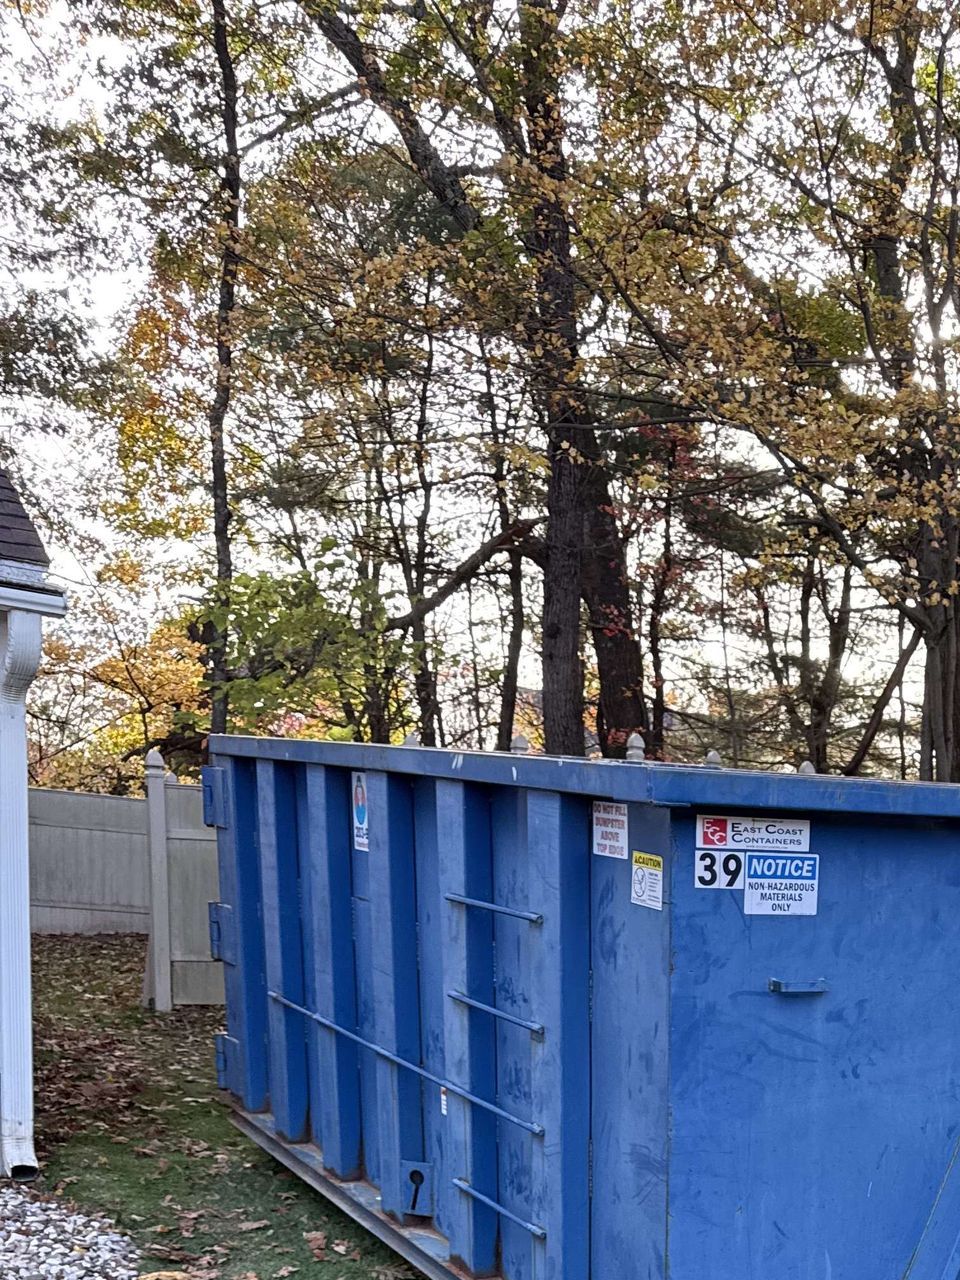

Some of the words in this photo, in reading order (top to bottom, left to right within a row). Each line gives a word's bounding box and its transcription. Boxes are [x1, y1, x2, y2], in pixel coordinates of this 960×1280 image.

[731, 822, 762, 834] EAST
[765, 824, 804, 836] COAST
[731, 833, 803, 846] CONTAINERS
[638, 855, 662, 869] CAUTION
[750, 858, 815, 877] NOTICE
[697, 852, 743, 887] 39
[748, 881, 815, 892] NON-HAZARDOUS
[760, 892, 803, 902] MATERIALS
[771, 903, 791, 912] ONLY
